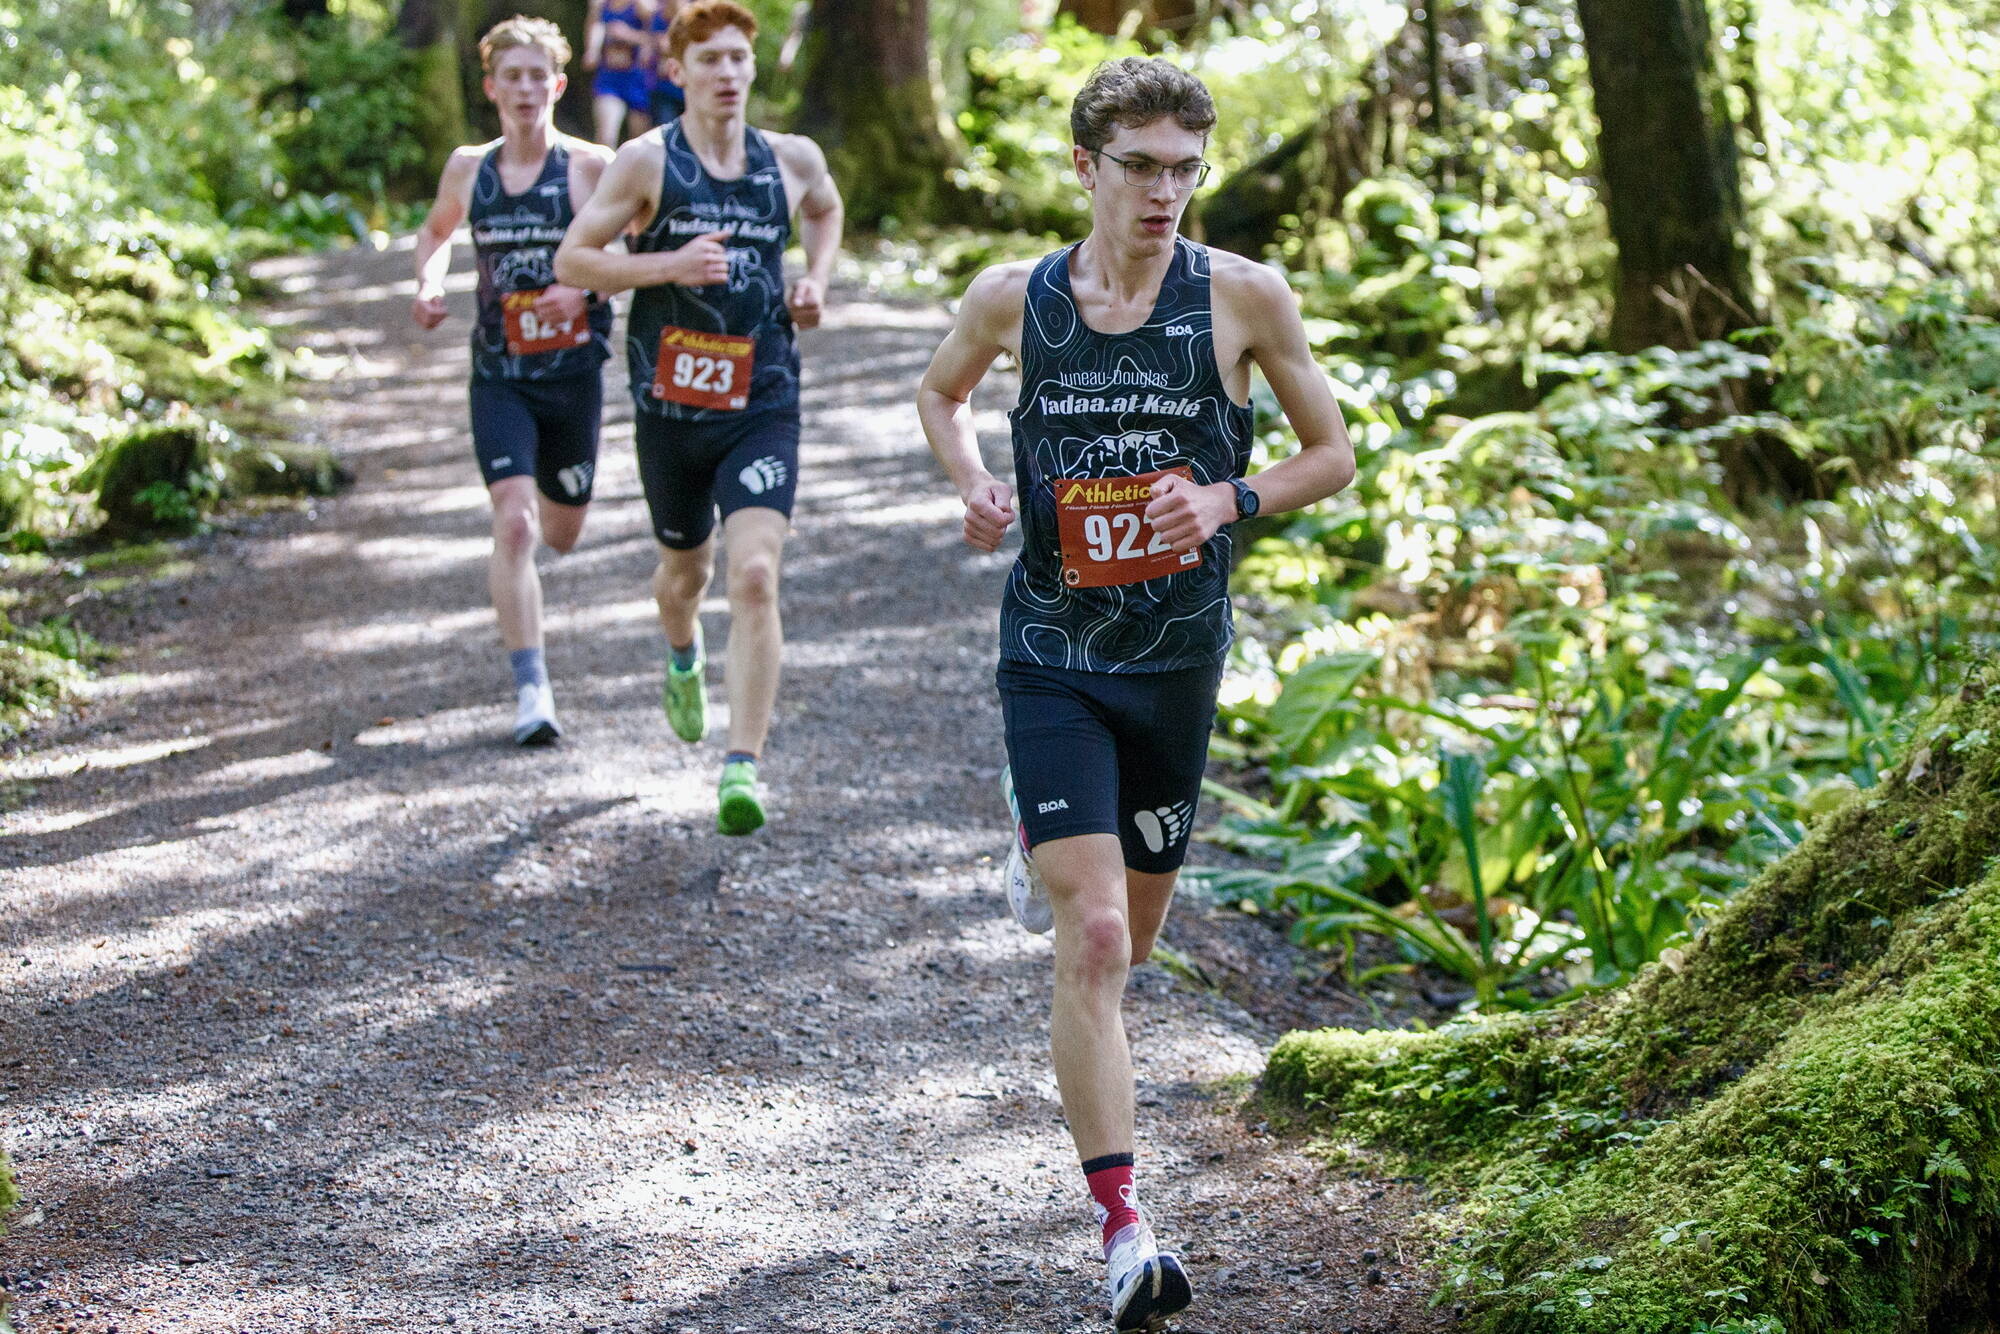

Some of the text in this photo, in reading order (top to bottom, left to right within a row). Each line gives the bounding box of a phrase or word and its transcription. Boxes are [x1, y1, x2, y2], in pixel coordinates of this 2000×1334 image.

[672, 352, 735, 395] 923
[1060, 370, 1169, 388] Juneau-Douglas
[1039, 394, 1140, 416] Yadaa.at
